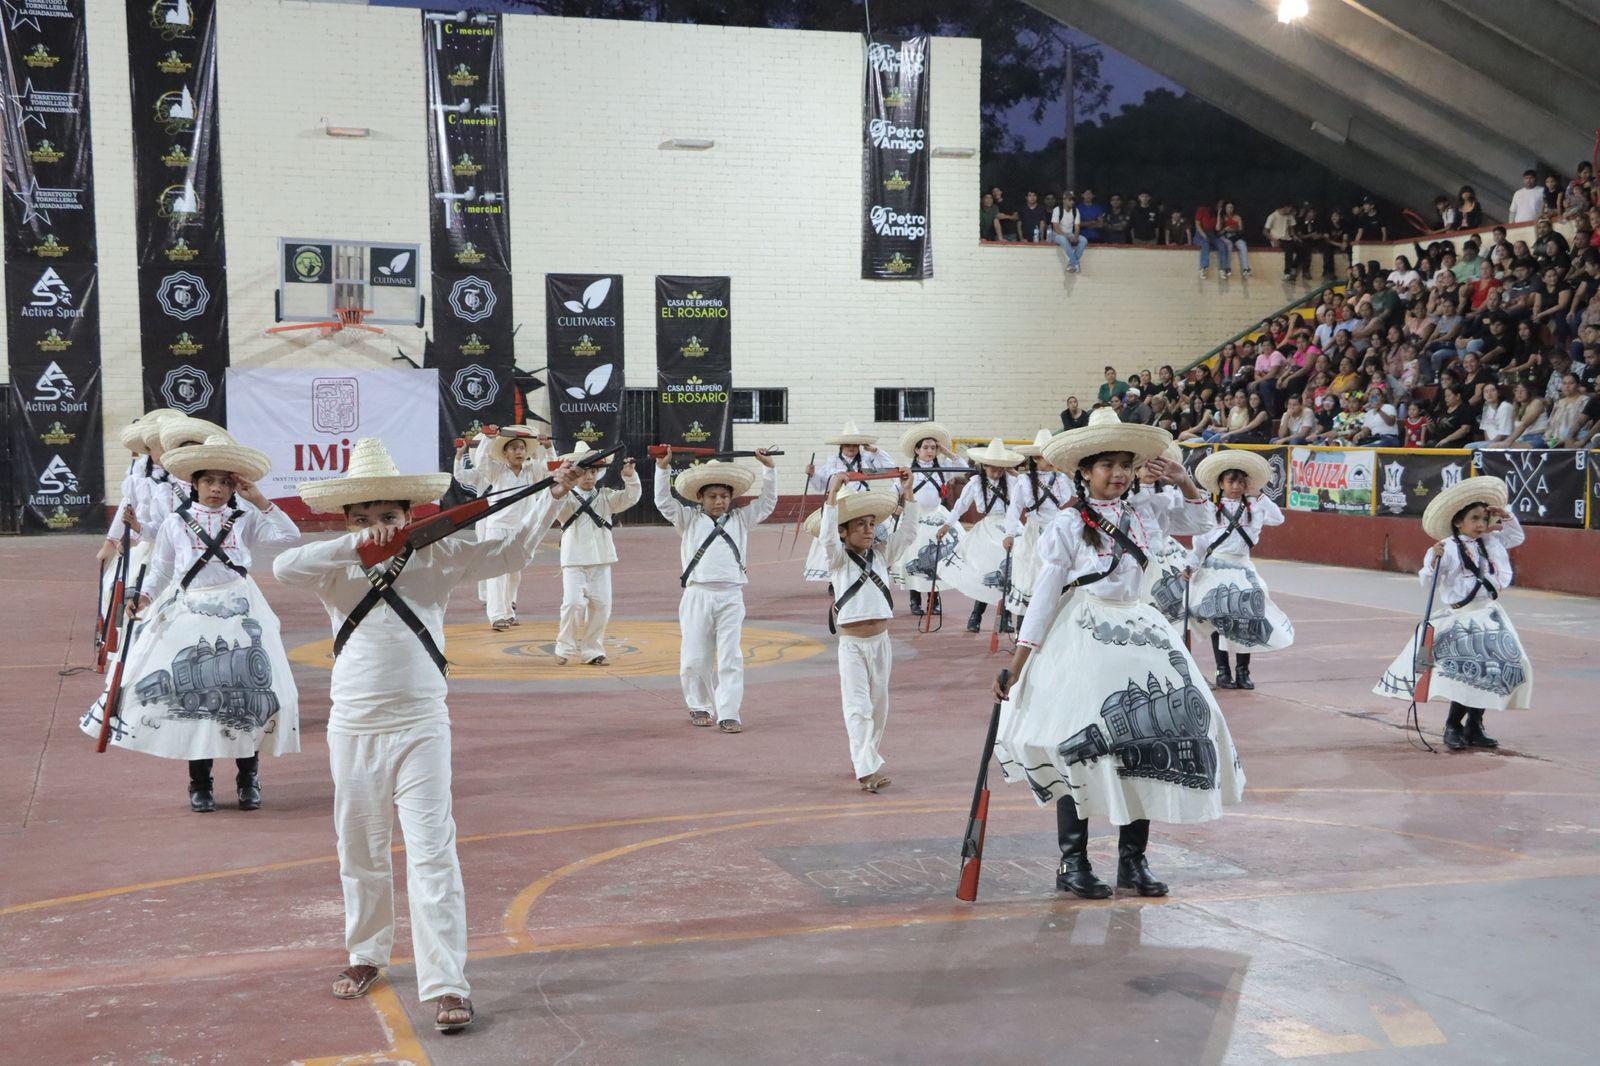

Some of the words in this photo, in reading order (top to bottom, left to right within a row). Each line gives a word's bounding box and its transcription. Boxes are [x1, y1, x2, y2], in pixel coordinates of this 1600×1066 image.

[888, 126, 924, 138] Petro
[881, 137, 924, 154] Amigo
[888, 212, 925, 224] Petro
[881, 223, 925, 240] Amigo
[696, 298, 723, 306] EMPEÑO
[22, 306, 54, 318] Activa
[57, 307, 84, 319] Sport
[662, 308, 674, 318] EL
[678, 308, 728, 318] ROSARIO
[558, 316, 616, 326] CULTIVARES
[696, 384, 723, 392] EMPEÑO
[662, 393, 674, 402] EL
[678, 392, 728, 402] ROSARIO
[25, 402, 57, 412] Activa
[60, 401, 88, 413] Sport
[560, 402, 618, 412] CULTIVARES
[1292, 460, 1348, 489] TAQUIZA
[1536, 474, 1549, 494] A
[28, 494, 60, 505] Activa
[64, 494, 91, 506] Sport
